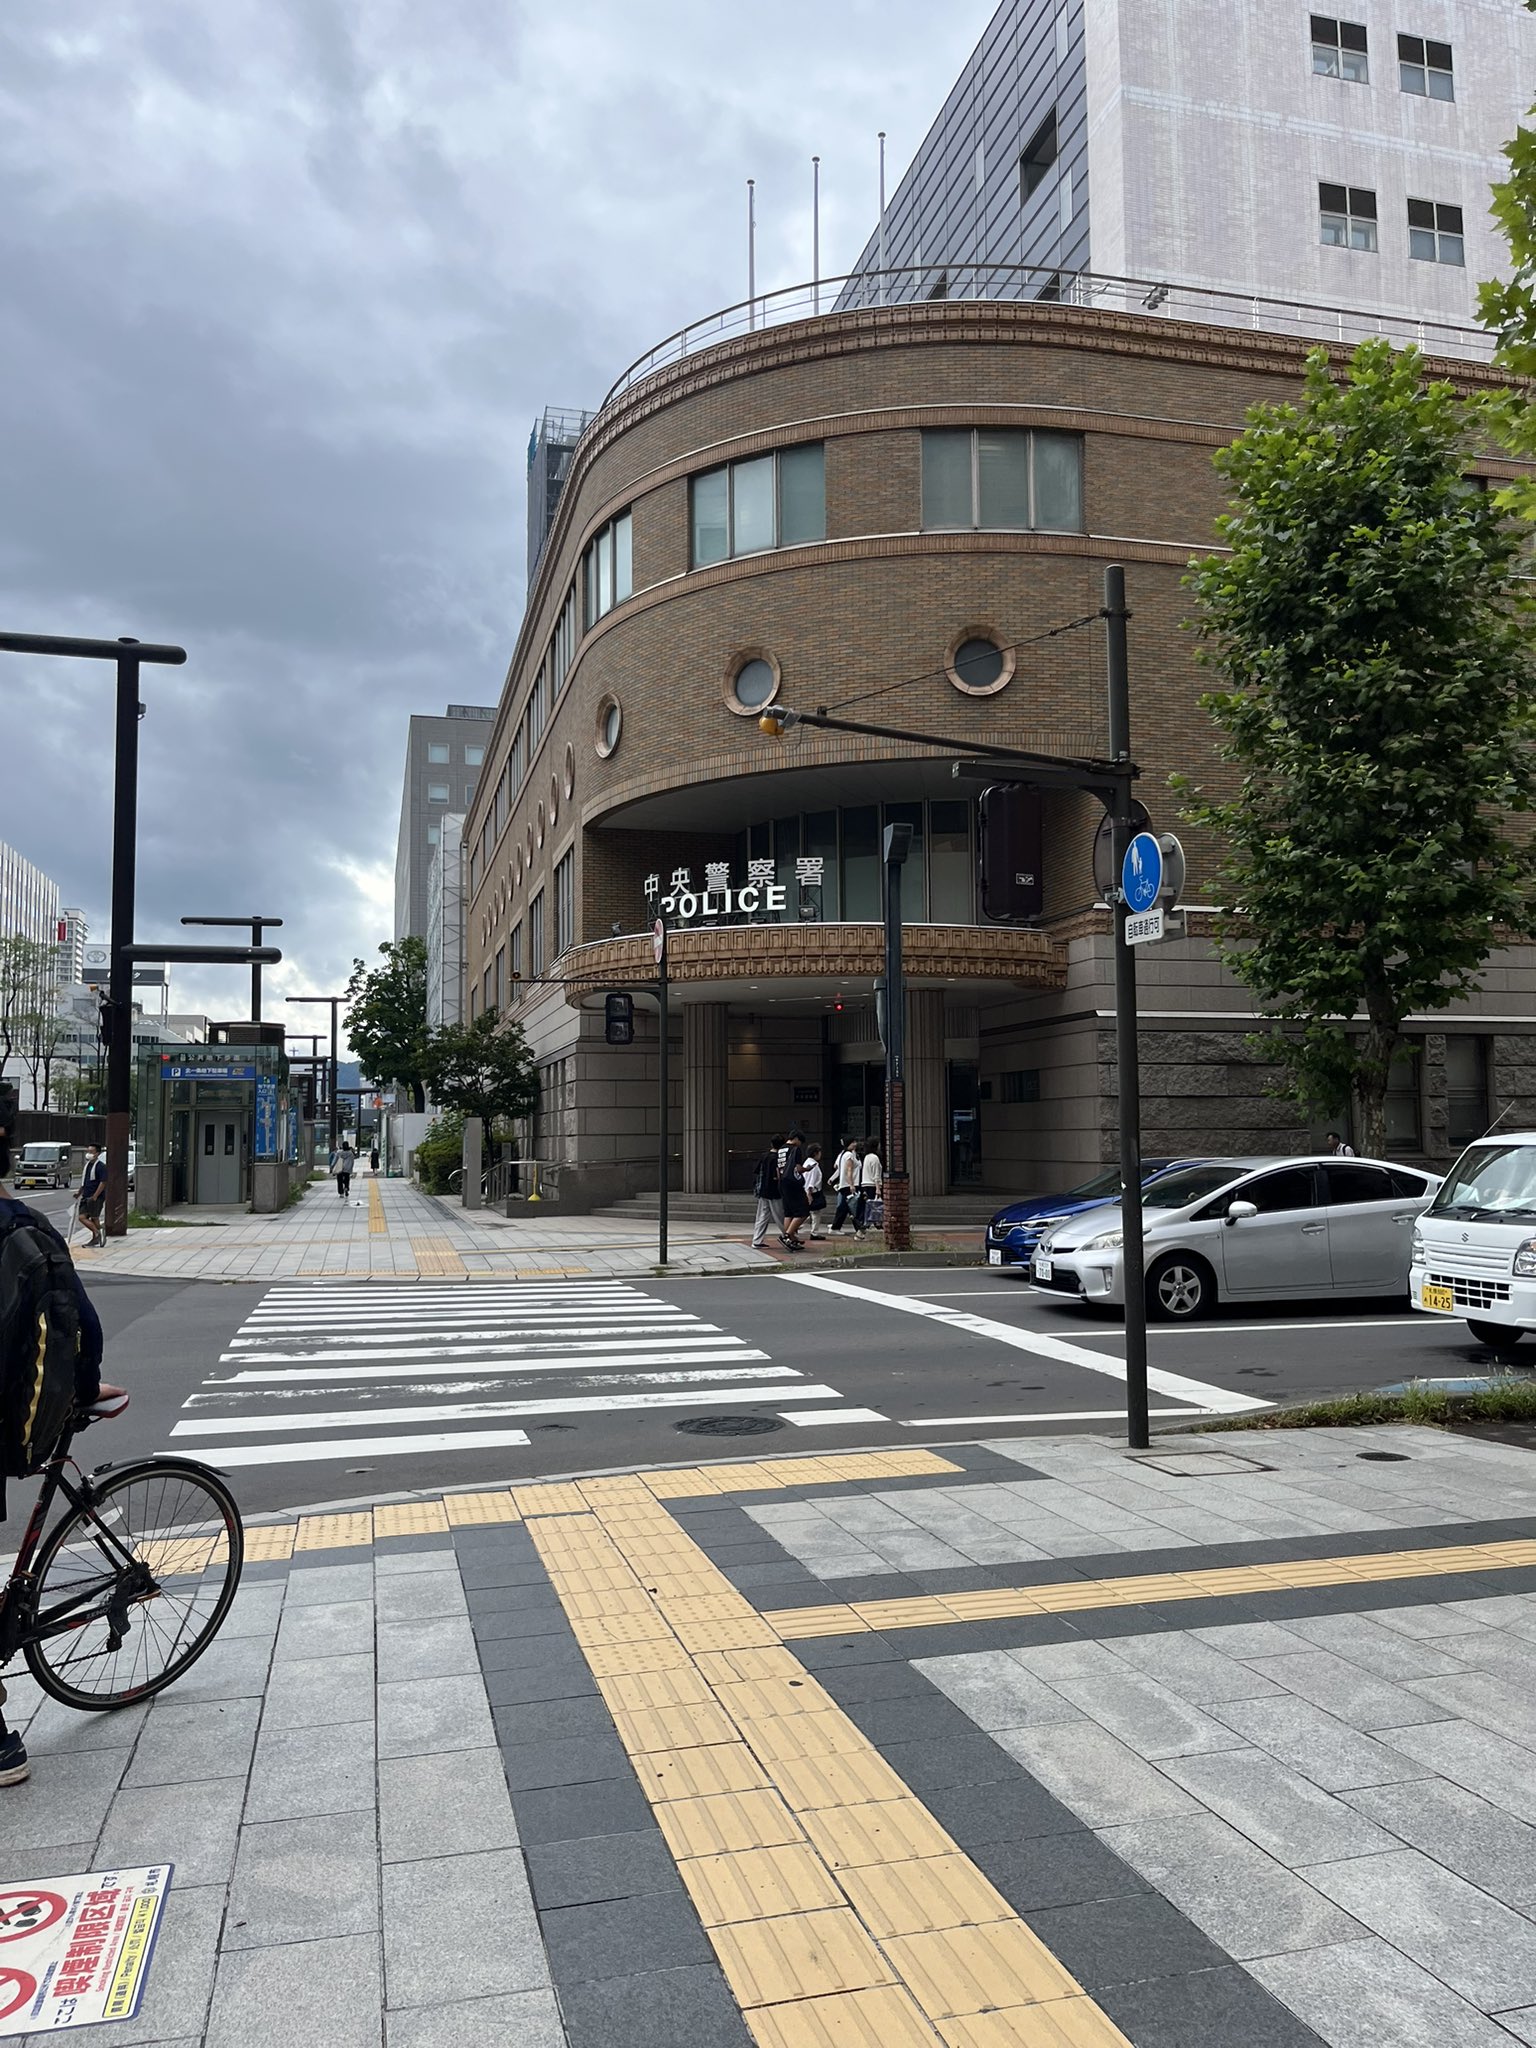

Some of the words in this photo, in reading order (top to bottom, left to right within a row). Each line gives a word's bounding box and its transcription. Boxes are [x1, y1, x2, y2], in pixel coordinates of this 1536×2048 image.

[644, 857, 825, 902] 中央警察署
[1128, 916, 1160, 939] 自転車通行可
